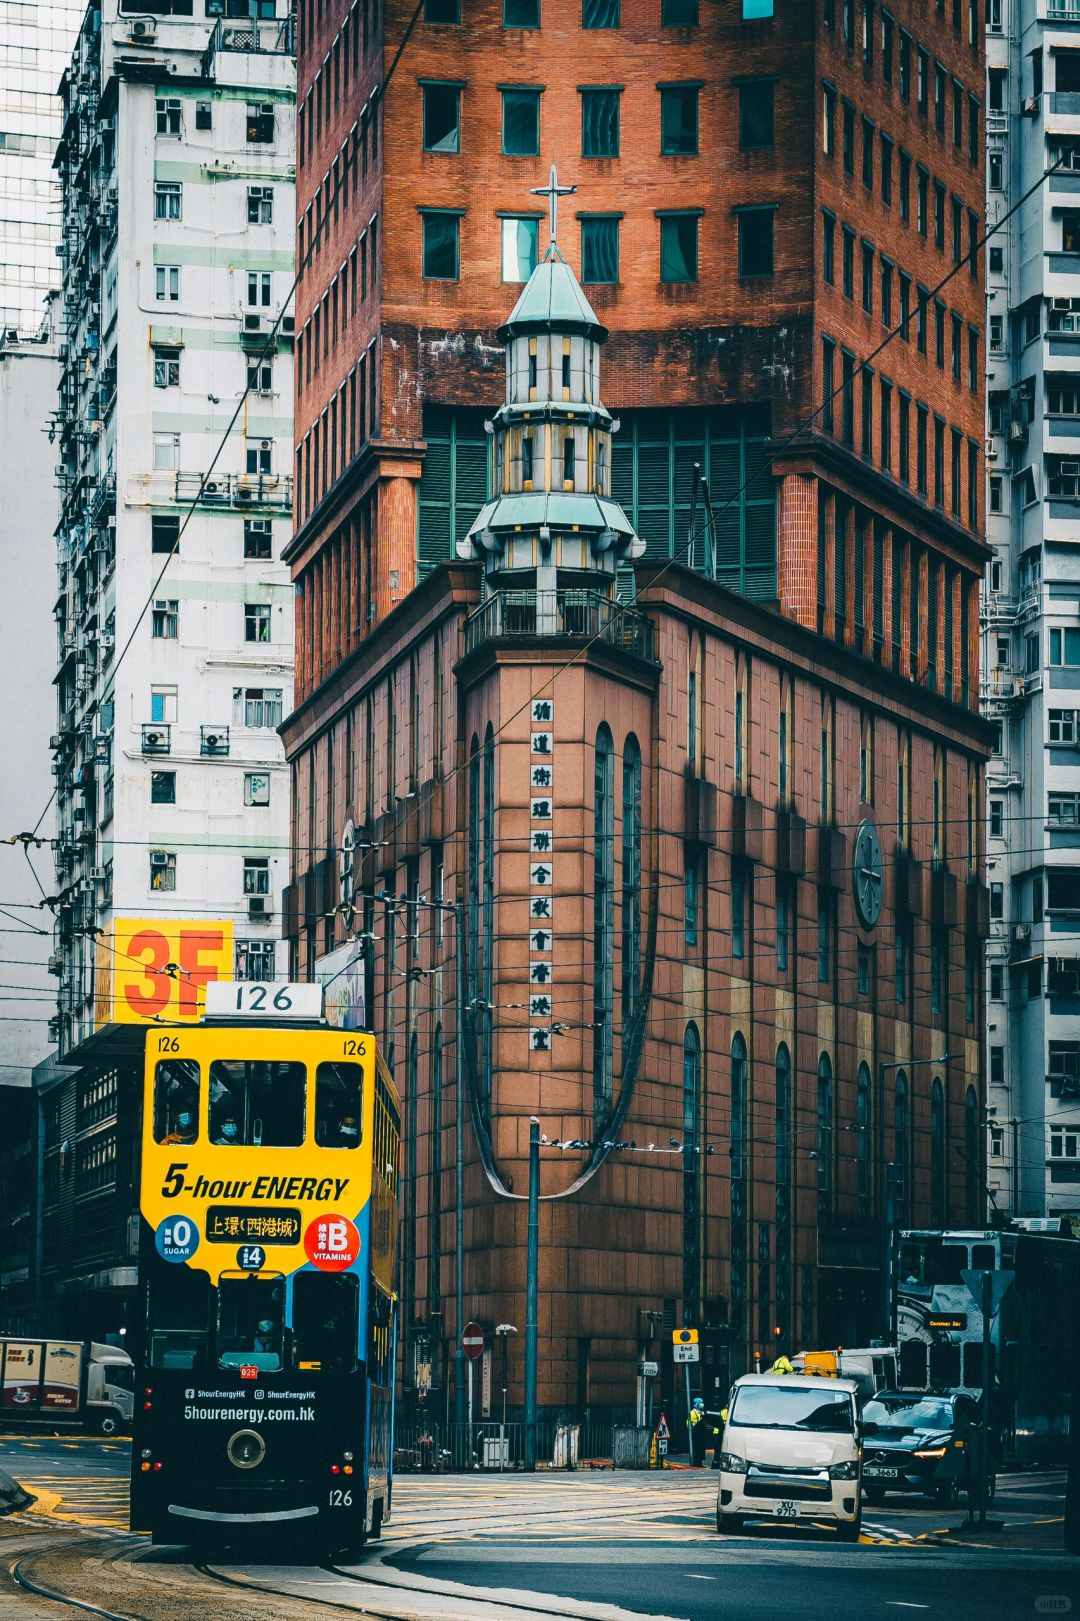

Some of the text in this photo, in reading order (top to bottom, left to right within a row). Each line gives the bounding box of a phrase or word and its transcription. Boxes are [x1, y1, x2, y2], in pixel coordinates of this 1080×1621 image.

[124, 929, 224, 1016] 3F
[236, 986, 293, 1011] 126
[157, 1036, 180, 1053] 126
[343, 1039, 366, 1056] 126
[161, 1163, 350, 1201] 5-hour ENERGY
[328, 1221, 348, 1252] B
[164, 1247, 190, 1255] SUGAR
[249, 1247, 261, 1264] 4
[313, 1252, 352, 1261] VITAMINS
[241, 1368, 256, 1377] 025
[197, 1389, 246, 1399] 5hourEnergyHK
[267, 1390, 316, 1400] 5hourEnergyHK
[184, 1405, 315, 1423] 5hourenergy.com.hk
[877, 1468, 898, 1477] 3665
[329, 1489, 353, 1507] 126
[781, 1501, 794, 1509] XU
[776, 1508, 797, 1517] 9713
